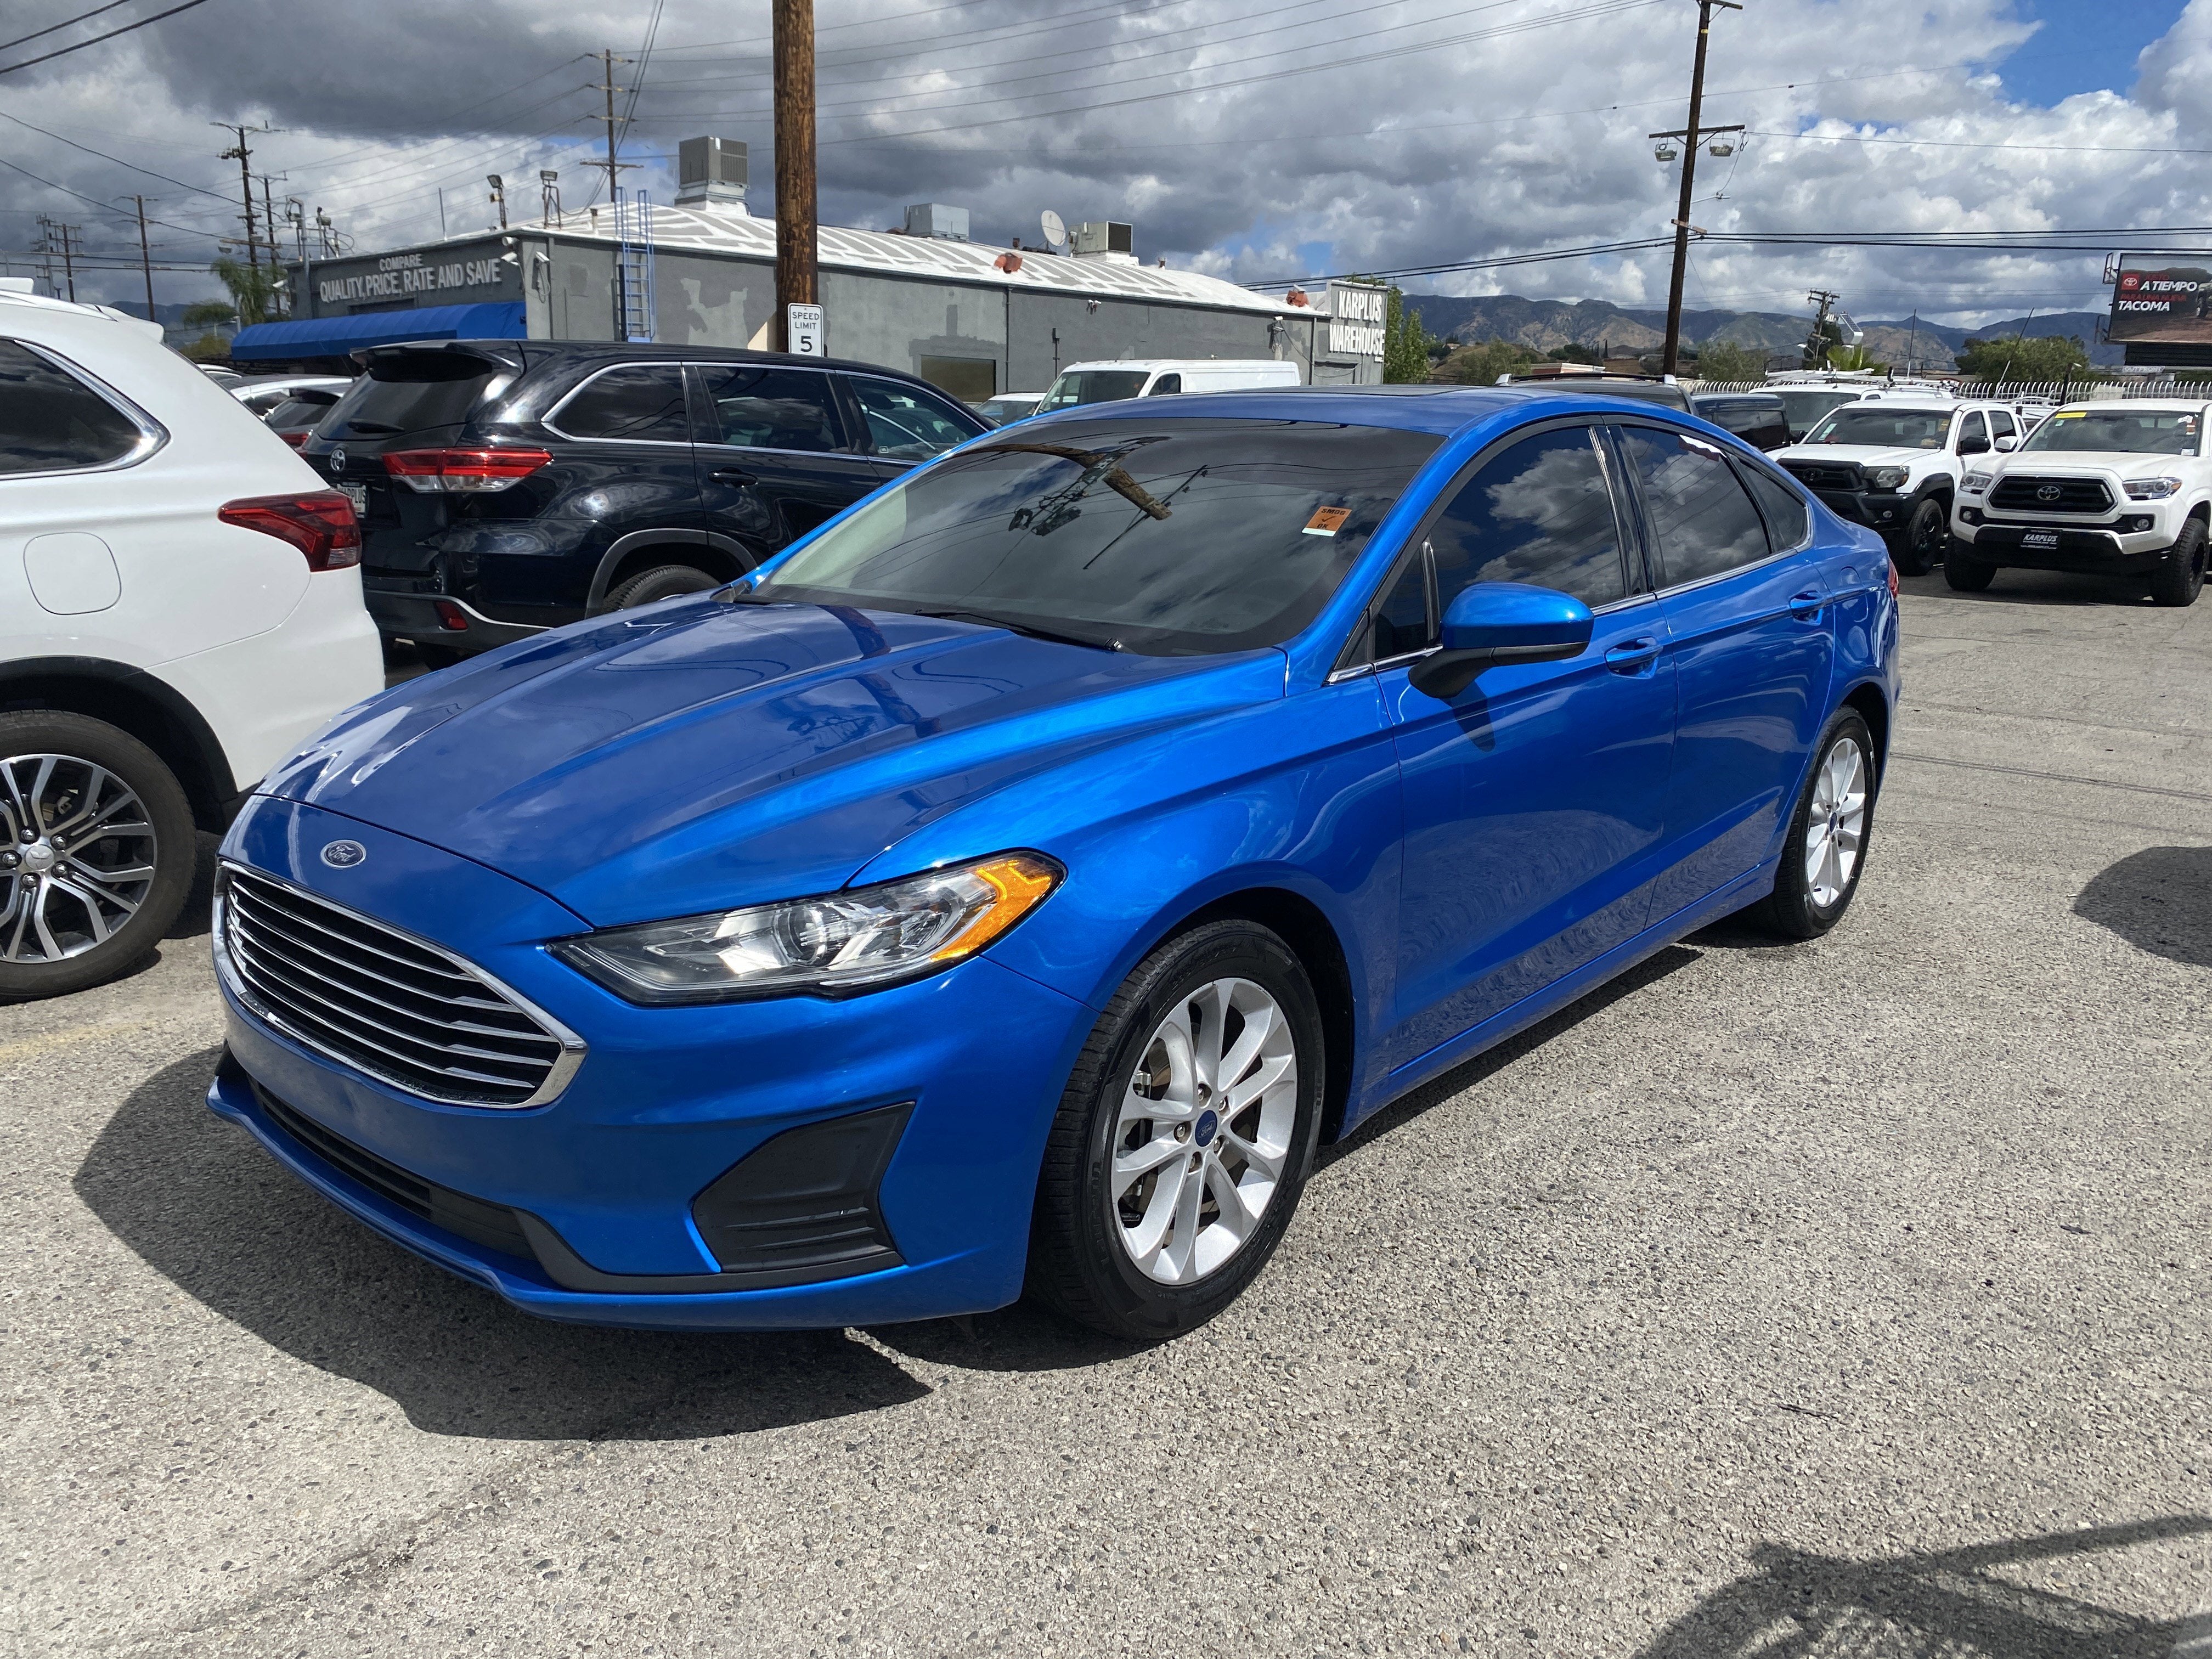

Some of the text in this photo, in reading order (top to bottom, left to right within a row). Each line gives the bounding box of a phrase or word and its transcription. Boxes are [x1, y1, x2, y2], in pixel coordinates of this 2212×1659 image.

[379, 253, 424, 272] COMPARE
[366, 272, 403, 298] PRICE,
[403, 267, 435, 292] RATE
[438, 263, 464, 289] AND
[466, 258, 502, 287] SAVE
[2140, 281, 2198, 292] A TIEMPO
[1338, 290, 1383, 322] KARPLUS
[2118, 300, 2170, 312] TACOMA
[792, 312, 820, 320] SPEED
[795, 321, 817, 330] LIMIT
[800, 335, 812, 352] 5
[1329, 324, 1385, 356] WAREHOUSE
[2023, 534, 2058, 542] KARPLUS
[328, 844, 357, 862] Ford
